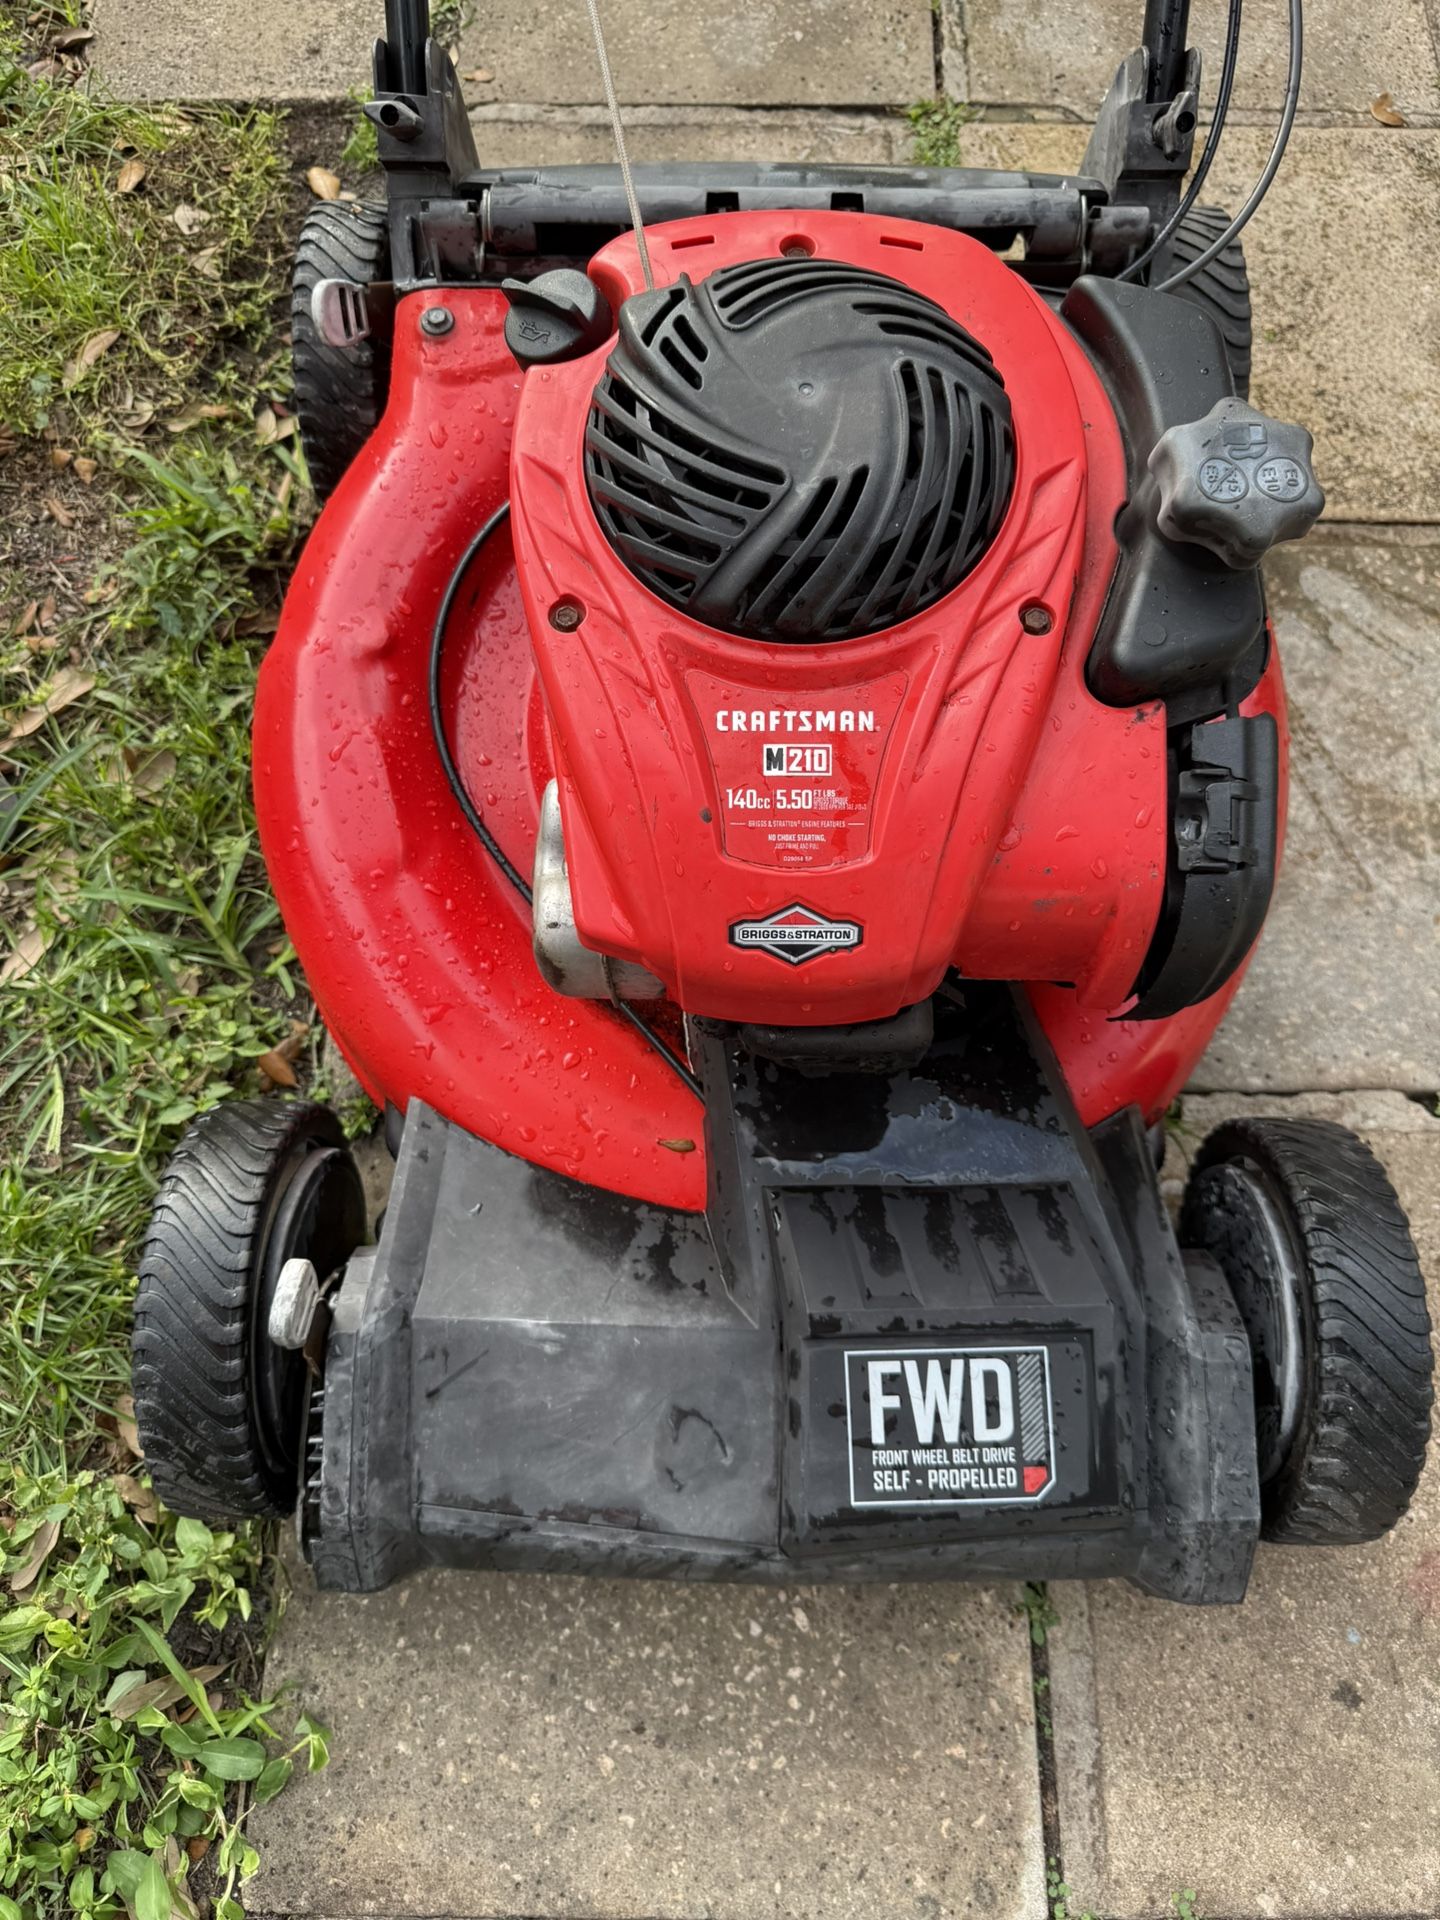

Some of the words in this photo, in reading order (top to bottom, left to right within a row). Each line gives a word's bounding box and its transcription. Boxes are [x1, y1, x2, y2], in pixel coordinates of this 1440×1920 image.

[1262, 467, 1281, 492] E10
[1283, 468, 1300, 487] E0
[716, 710, 875, 732] CRAFTSMAN
[726, 789, 771, 809] 140cc
[776, 789, 813, 809] 5.50
[823, 789, 836, 798] LBS
[748, 820, 767, 828] BRIGGS
[801, 820, 820, 828] ENGINE
[820, 820, 846, 828] FEATURES
[768, 833, 777, 841] NO
[777, 833, 796, 841] CHOKE
[797, 833, 827, 842] STARTING,
[867, 1358, 1016, 1445] FWD
[872, 1449, 909, 1466] FRONT
[911, 1449, 950, 1466] WHEEL
[952, 1448, 980, 1465] BELT
[982, 1447, 1016, 1464] DRIVE
[873, 1470, 911, 1491] SELF
[928, 1467, 1018, 1490] PROPELLED
